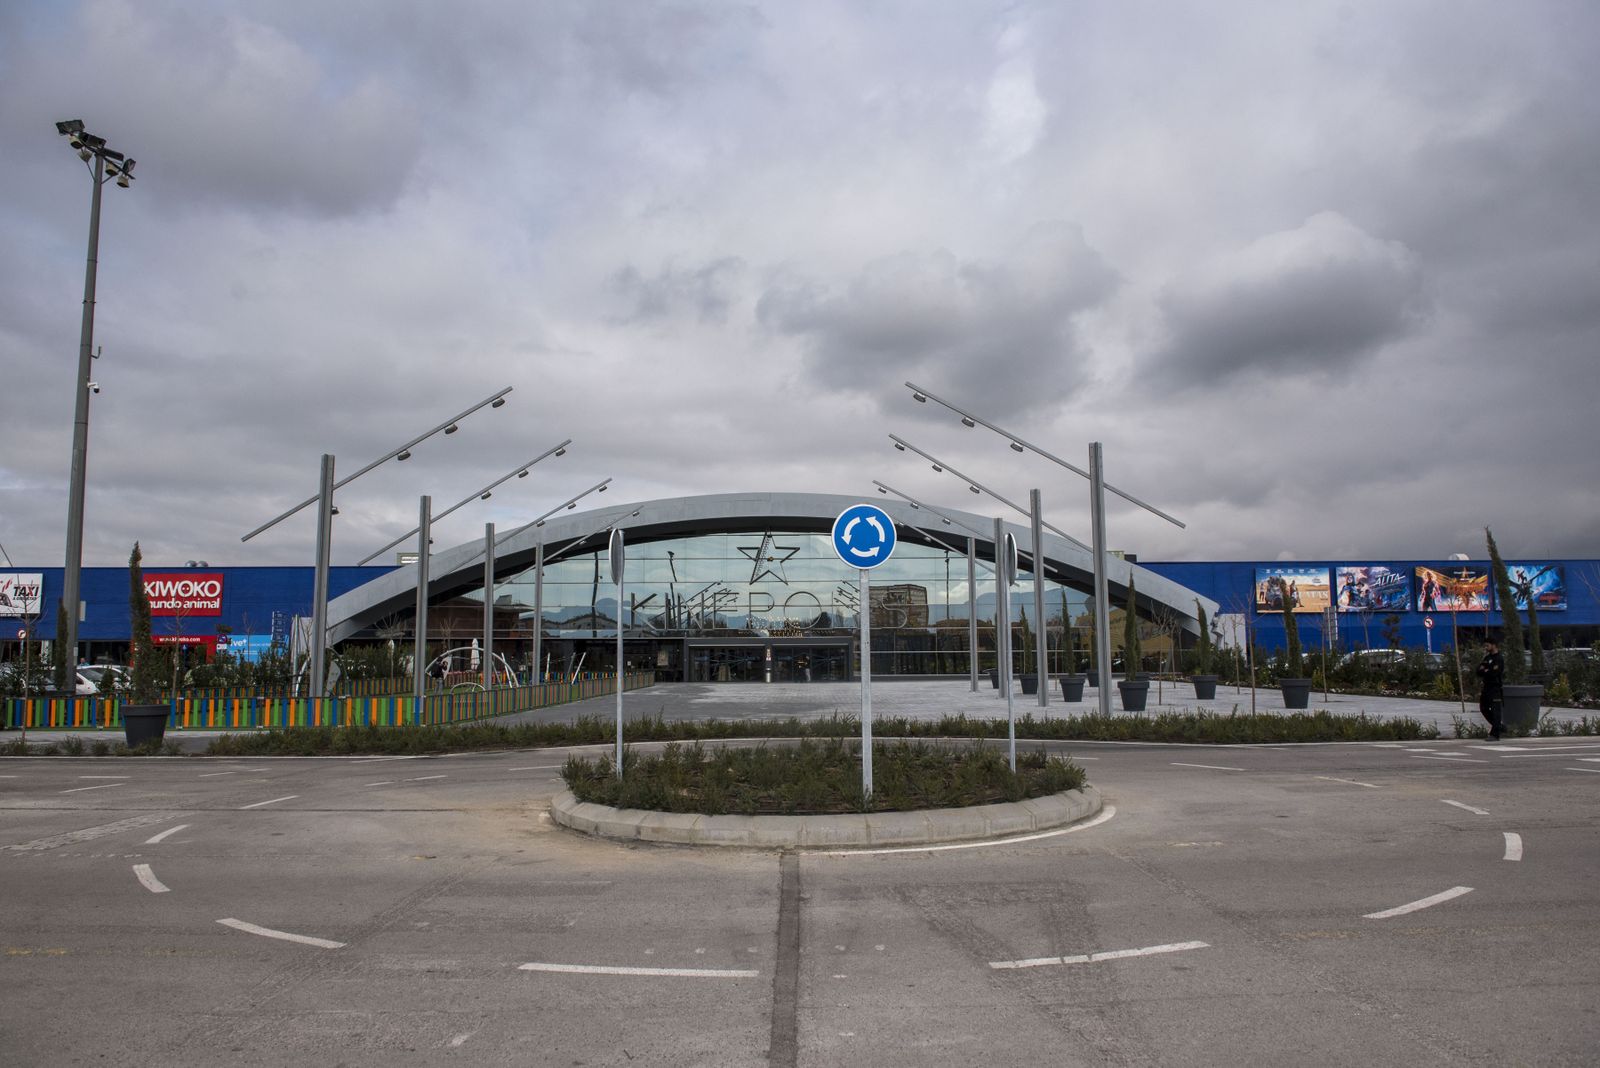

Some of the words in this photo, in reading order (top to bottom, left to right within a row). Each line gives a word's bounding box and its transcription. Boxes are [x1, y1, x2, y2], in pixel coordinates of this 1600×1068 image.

[1371, 573, 1405, 586] ALITA
[13, 586, 40, 597] TAXI
[143, 580, 221, 597] KIWOKO
[183, 598, 220, 609] animal
[629, 591, 908, 630] KINEPOLS
